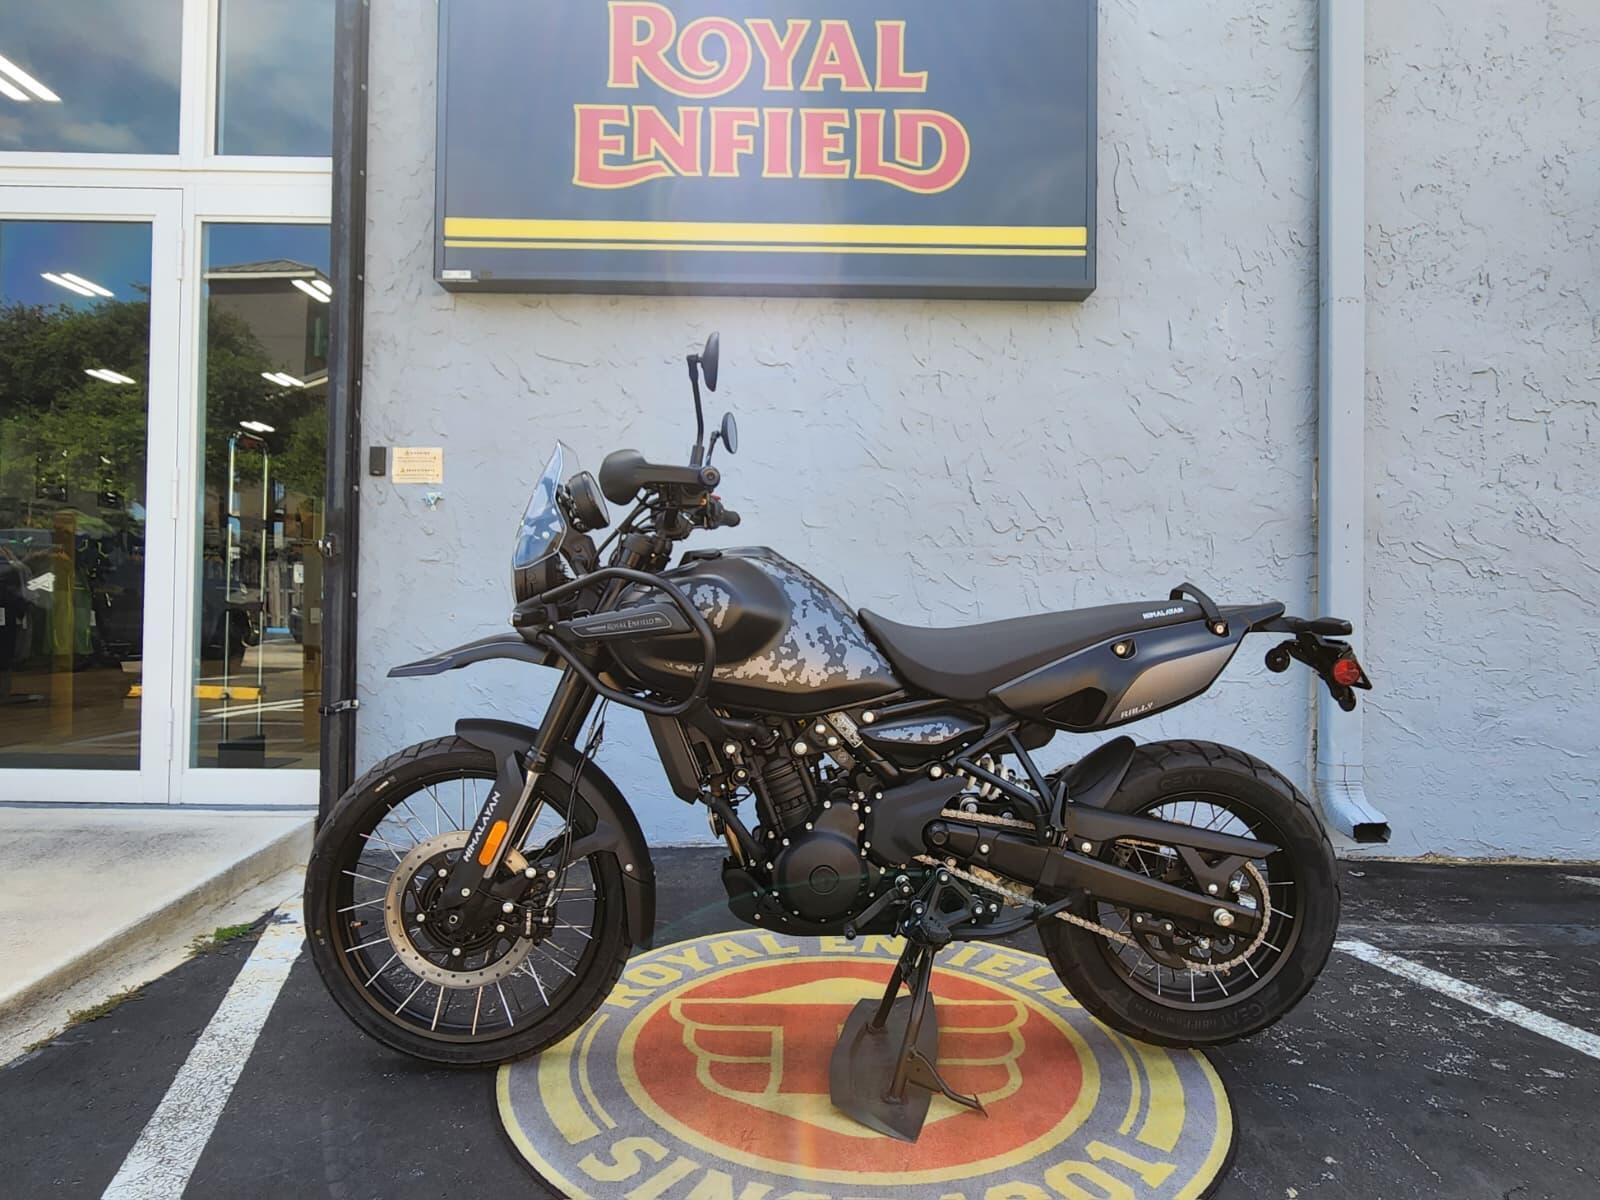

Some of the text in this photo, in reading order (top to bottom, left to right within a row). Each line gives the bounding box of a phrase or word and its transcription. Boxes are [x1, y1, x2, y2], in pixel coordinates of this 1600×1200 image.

[607, 1, 929, 98] ROYAL
[573, 104, 971, 194] ENFIELD
[463, 790, 501, 863] HIMALAYAN
[604, 934, 800, 1008] ROYAL
